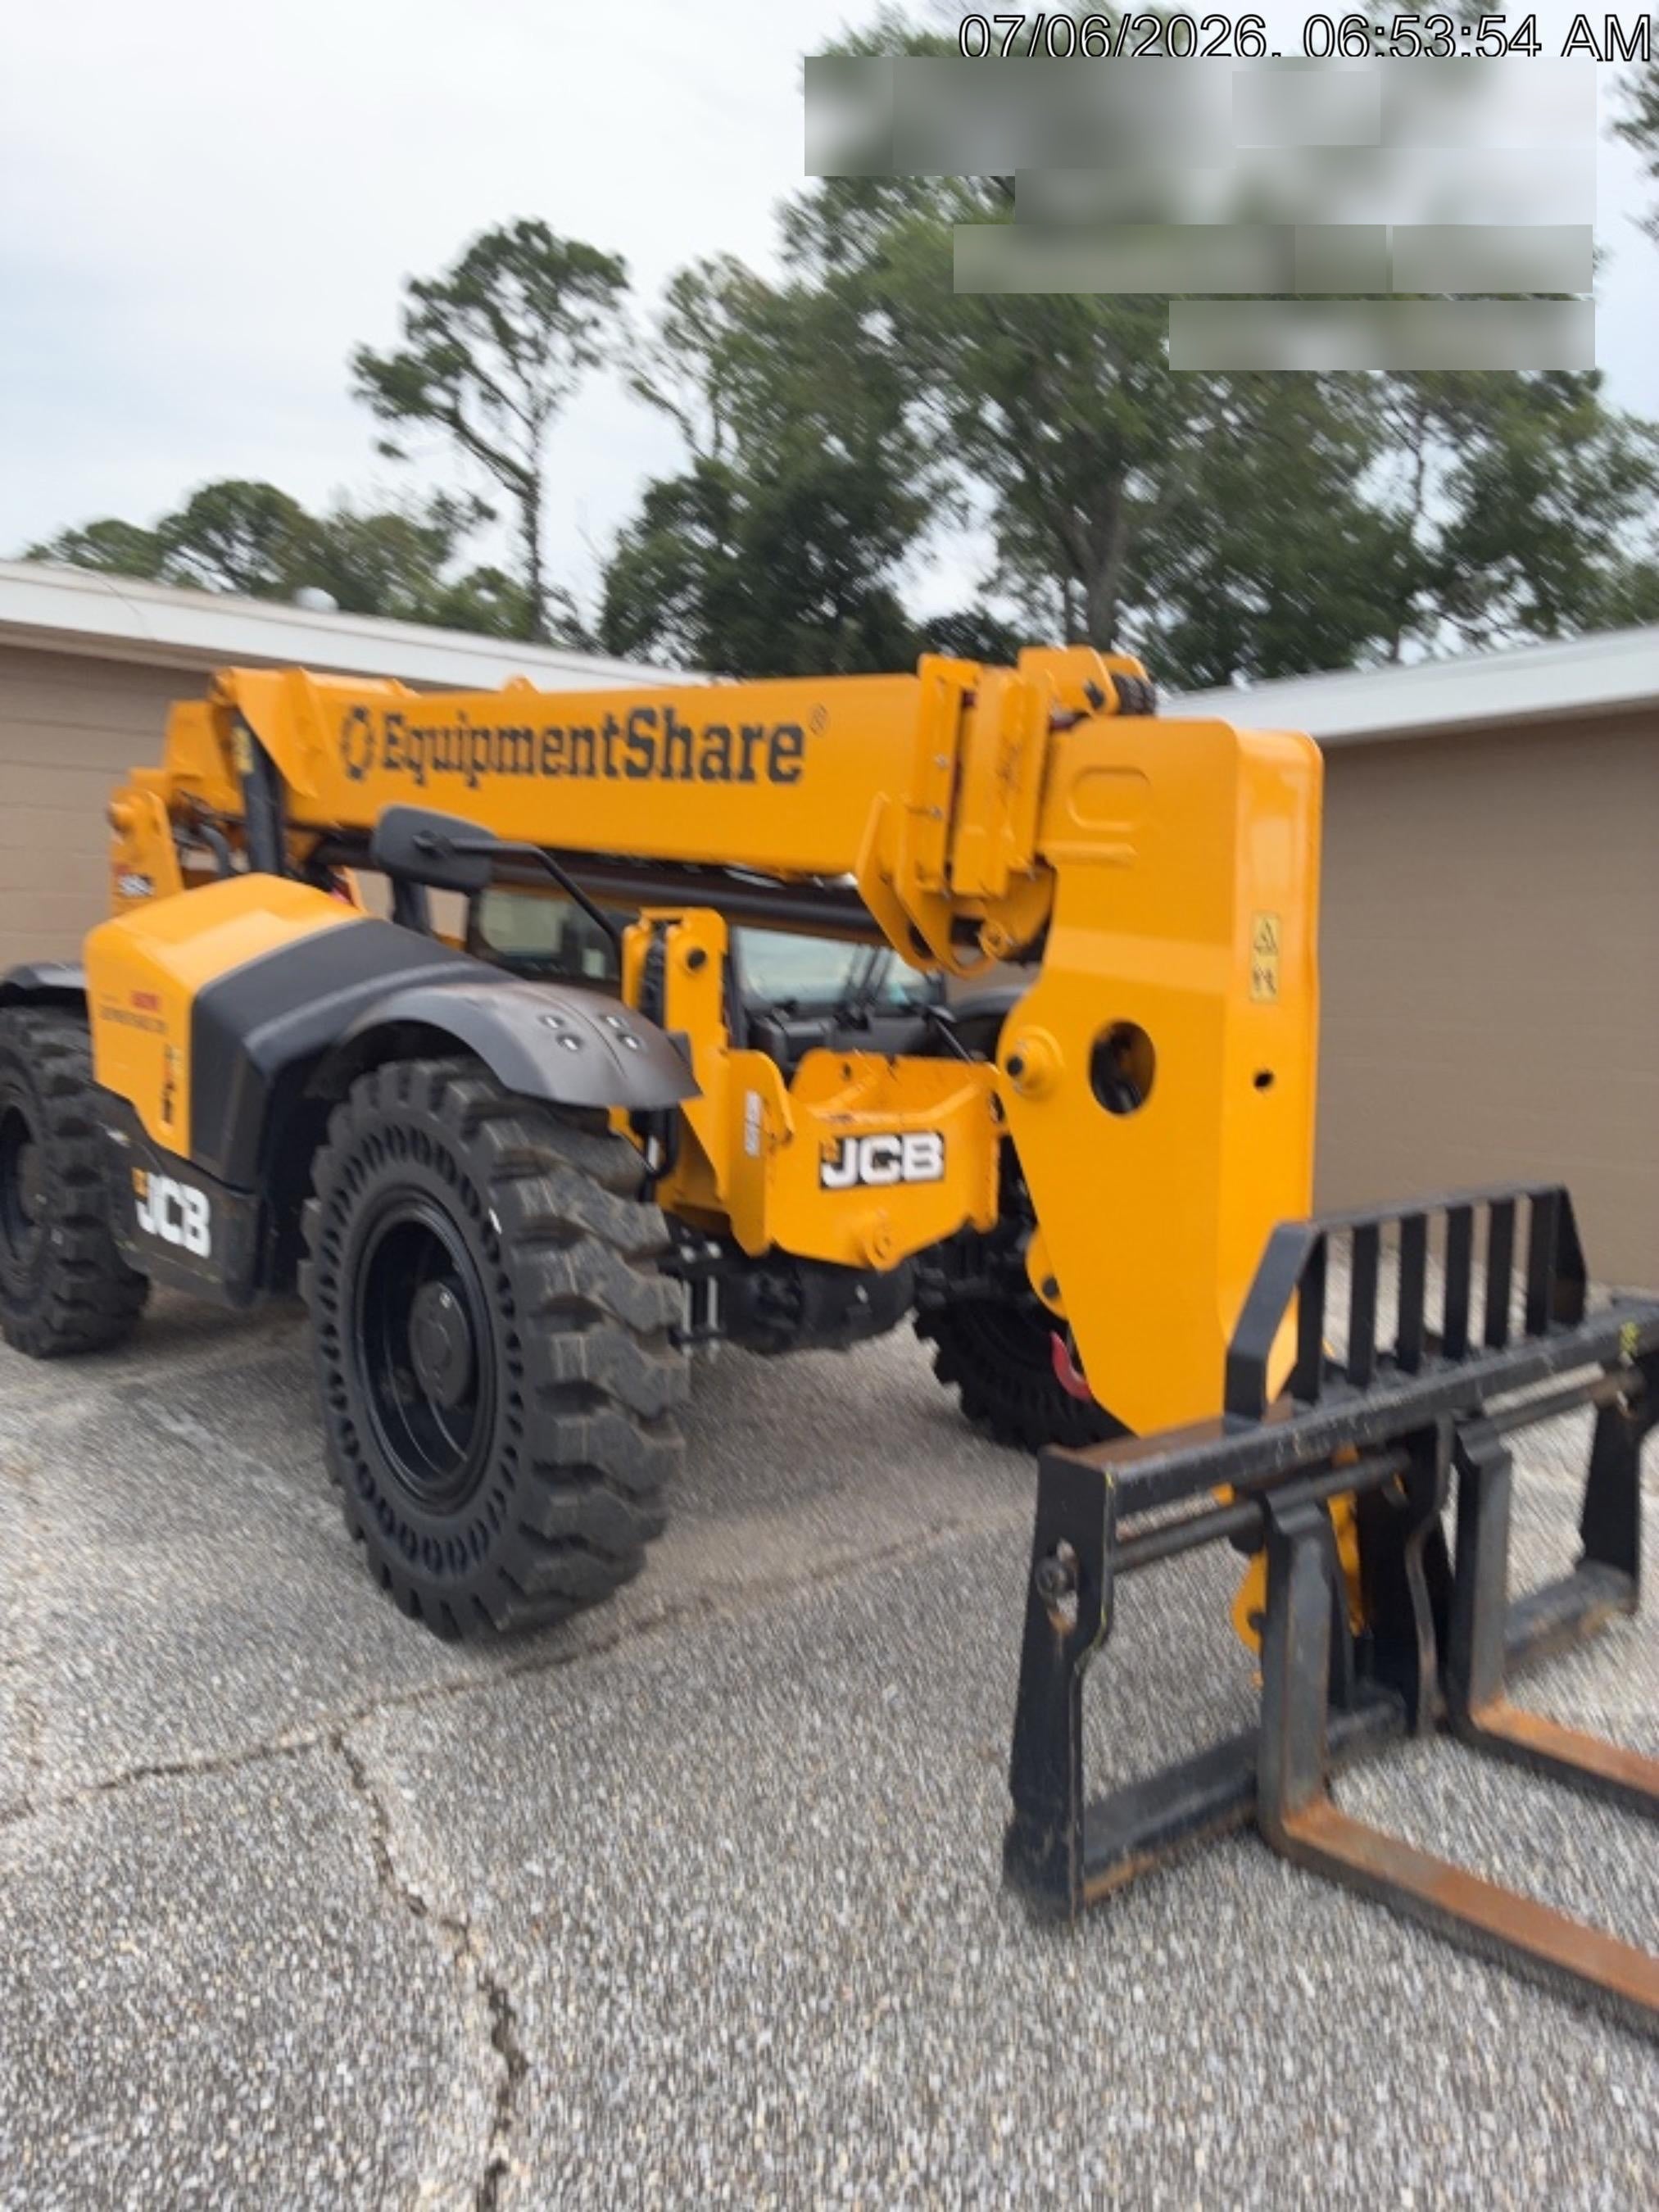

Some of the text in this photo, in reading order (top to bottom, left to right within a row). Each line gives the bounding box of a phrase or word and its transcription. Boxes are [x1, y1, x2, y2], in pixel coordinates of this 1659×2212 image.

[382, 706, 805, 788] EquipmentShare
[821, 1131, 944, 1189] JCB
[132, 1168, 211, 1258] JCB
